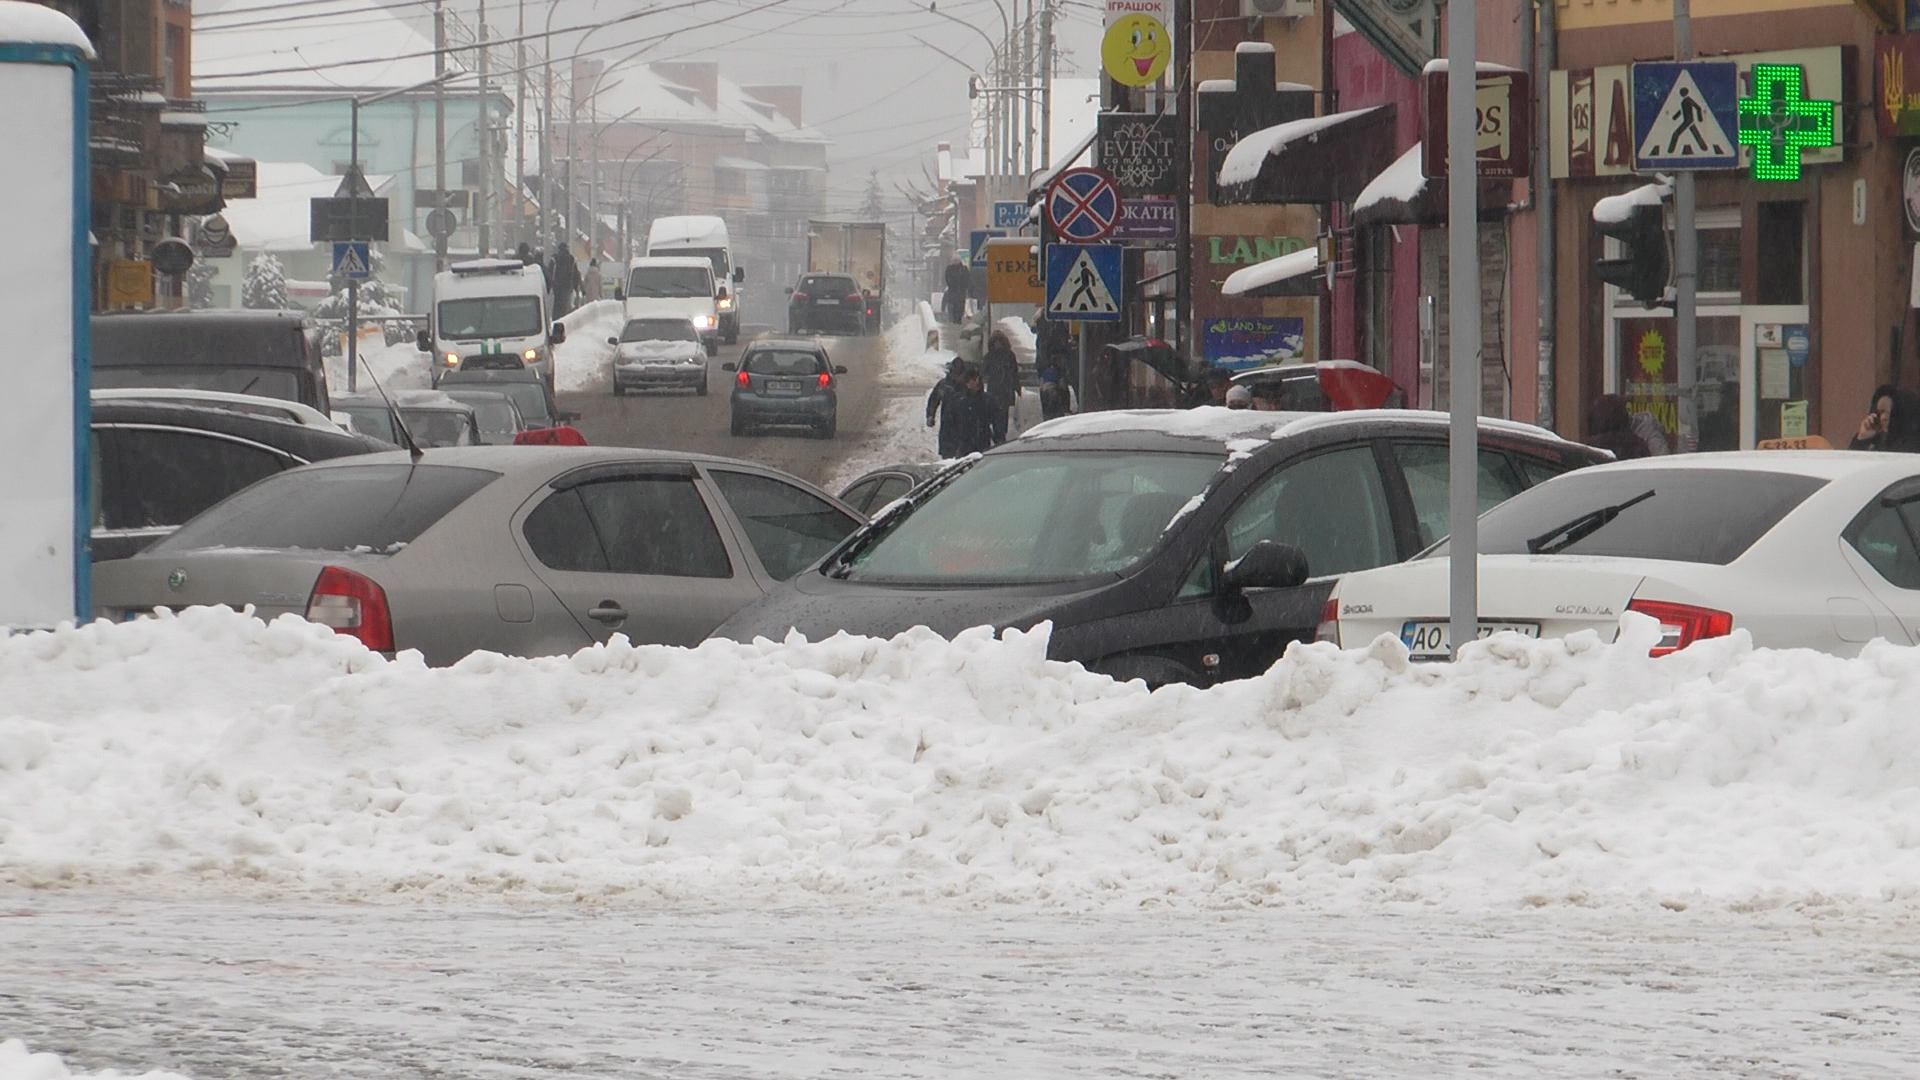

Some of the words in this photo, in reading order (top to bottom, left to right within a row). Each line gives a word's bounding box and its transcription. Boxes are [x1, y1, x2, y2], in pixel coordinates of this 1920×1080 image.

[1108, 2, 1162, 12] ІГРАШОК
[1104, 140, 1173, 157] EVENT
[1102, 157, 1172, 166] company
[1227, 321, 1254, 331] LAND
[1554, 605, 1613, 615] OCTAVIA
[1412, 627, 1442, 650] AO
